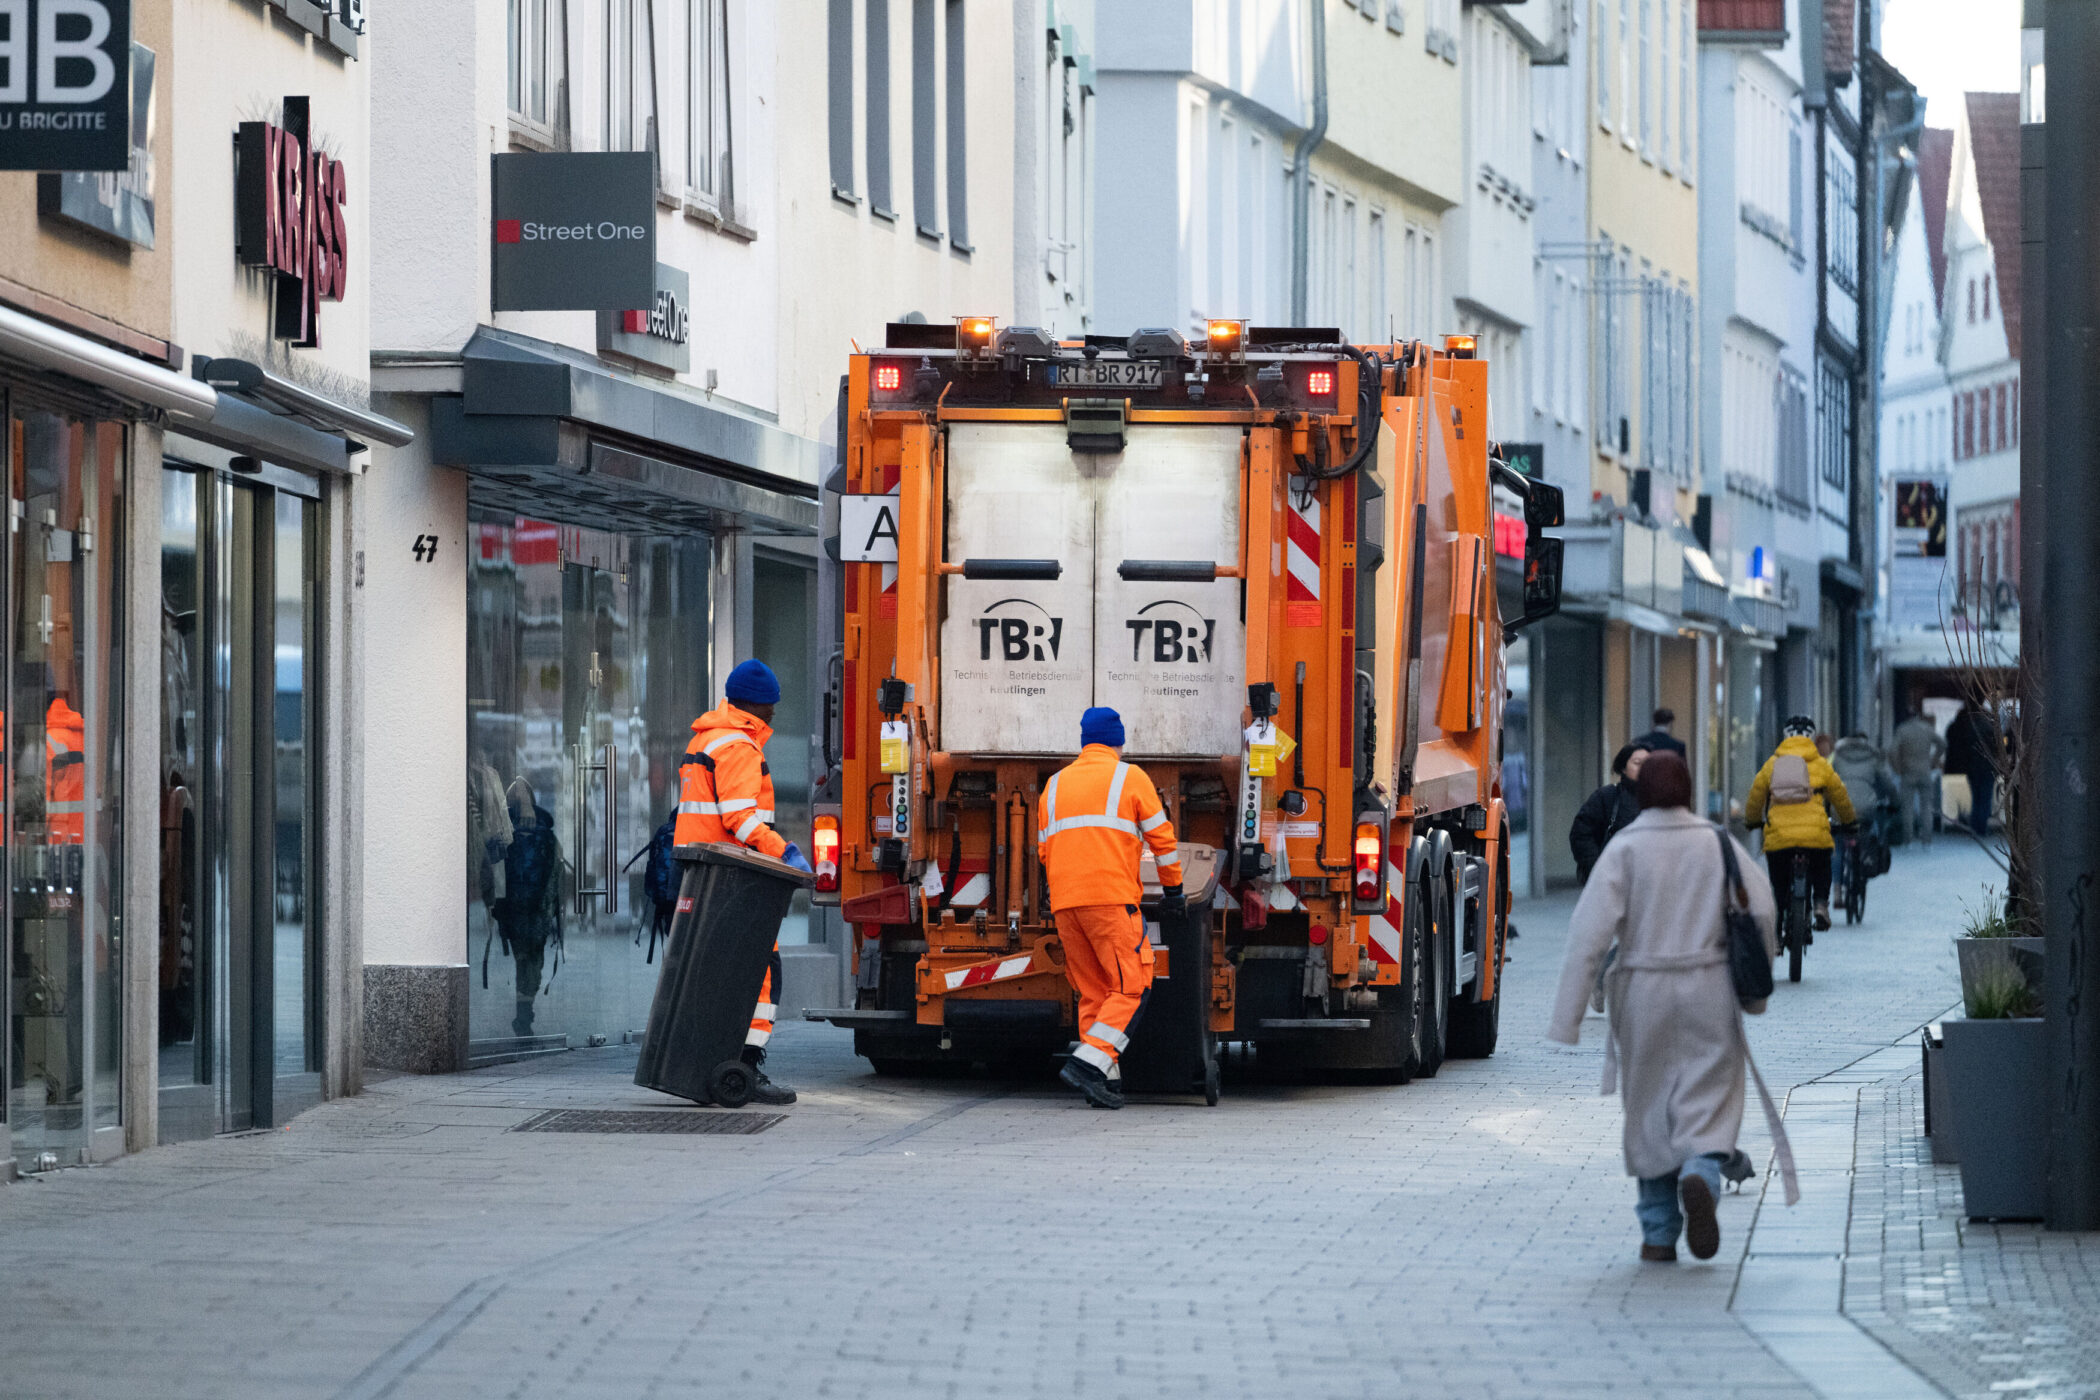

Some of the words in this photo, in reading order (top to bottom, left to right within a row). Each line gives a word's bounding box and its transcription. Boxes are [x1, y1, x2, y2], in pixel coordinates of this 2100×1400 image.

[19, 111, 107, 130] BRIGITTE
[264, 96, 347, 349] KRASS
[523, 222, 594, 241] Street
[597, 221, 646, 241] One
[668, 289, 689, 344] One
[1058, 364, 1080, 383] RT
[1095, 364, 1121, 383] BR
[1125, 365, 1160, 384] 917
[864, 505, 899, 552] A
[411, 533, 439, 563] 47
[971, 617, 1063, 662] TBR
[1125, 618, 1217, 663] TBR
[953, 669, 989, 681] Technis
